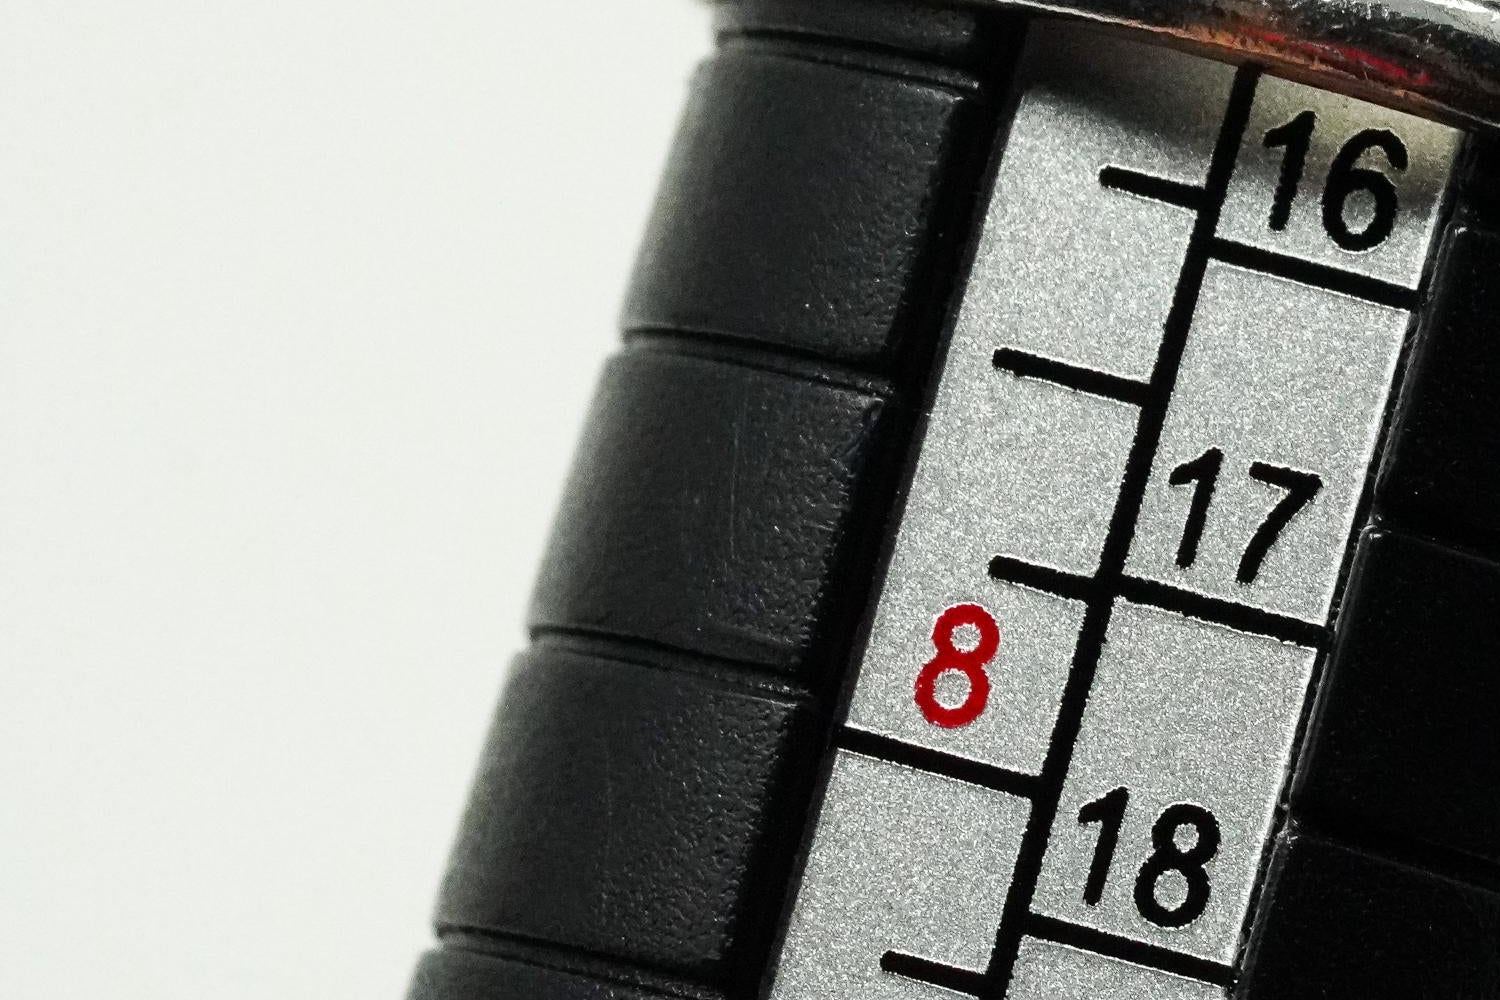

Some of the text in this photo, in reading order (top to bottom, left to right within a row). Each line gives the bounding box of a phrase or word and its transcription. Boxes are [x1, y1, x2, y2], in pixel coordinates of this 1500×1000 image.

[1263, 110, 1408, 252] 16
[1168, 446, 1325, 589] 17
[913, 603, 1000, 730] 8
[1077, 786, 1223, 930] 18
